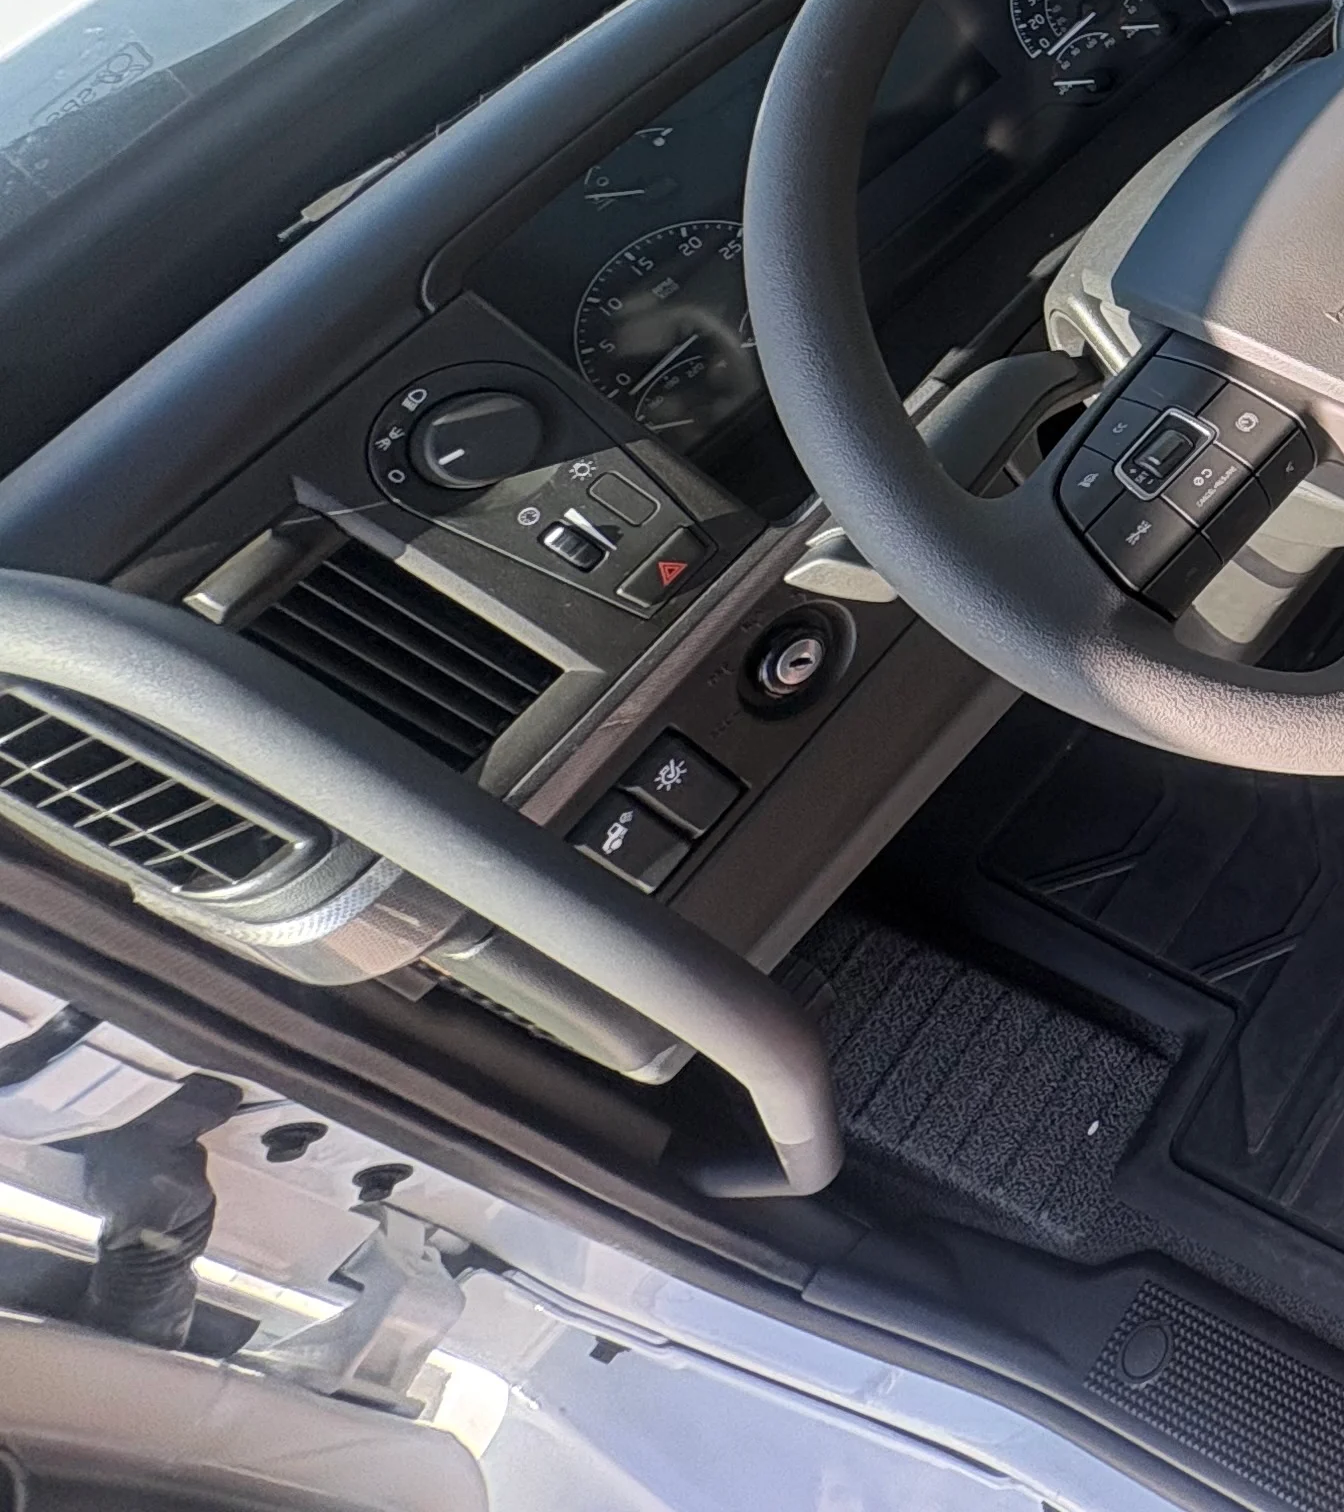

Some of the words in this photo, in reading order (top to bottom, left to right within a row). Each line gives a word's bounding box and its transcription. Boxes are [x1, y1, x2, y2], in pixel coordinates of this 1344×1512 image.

[1028, 13, 1045, 30] 20
[678, 235, 703, 256] 20
[719, 239, 743, 261] 25
[632, 257, 654, 276] 15
[600, 297, 623, 316] 10
[600, 339, 616, 353] 5
[616, 372, 632, 386] 0
